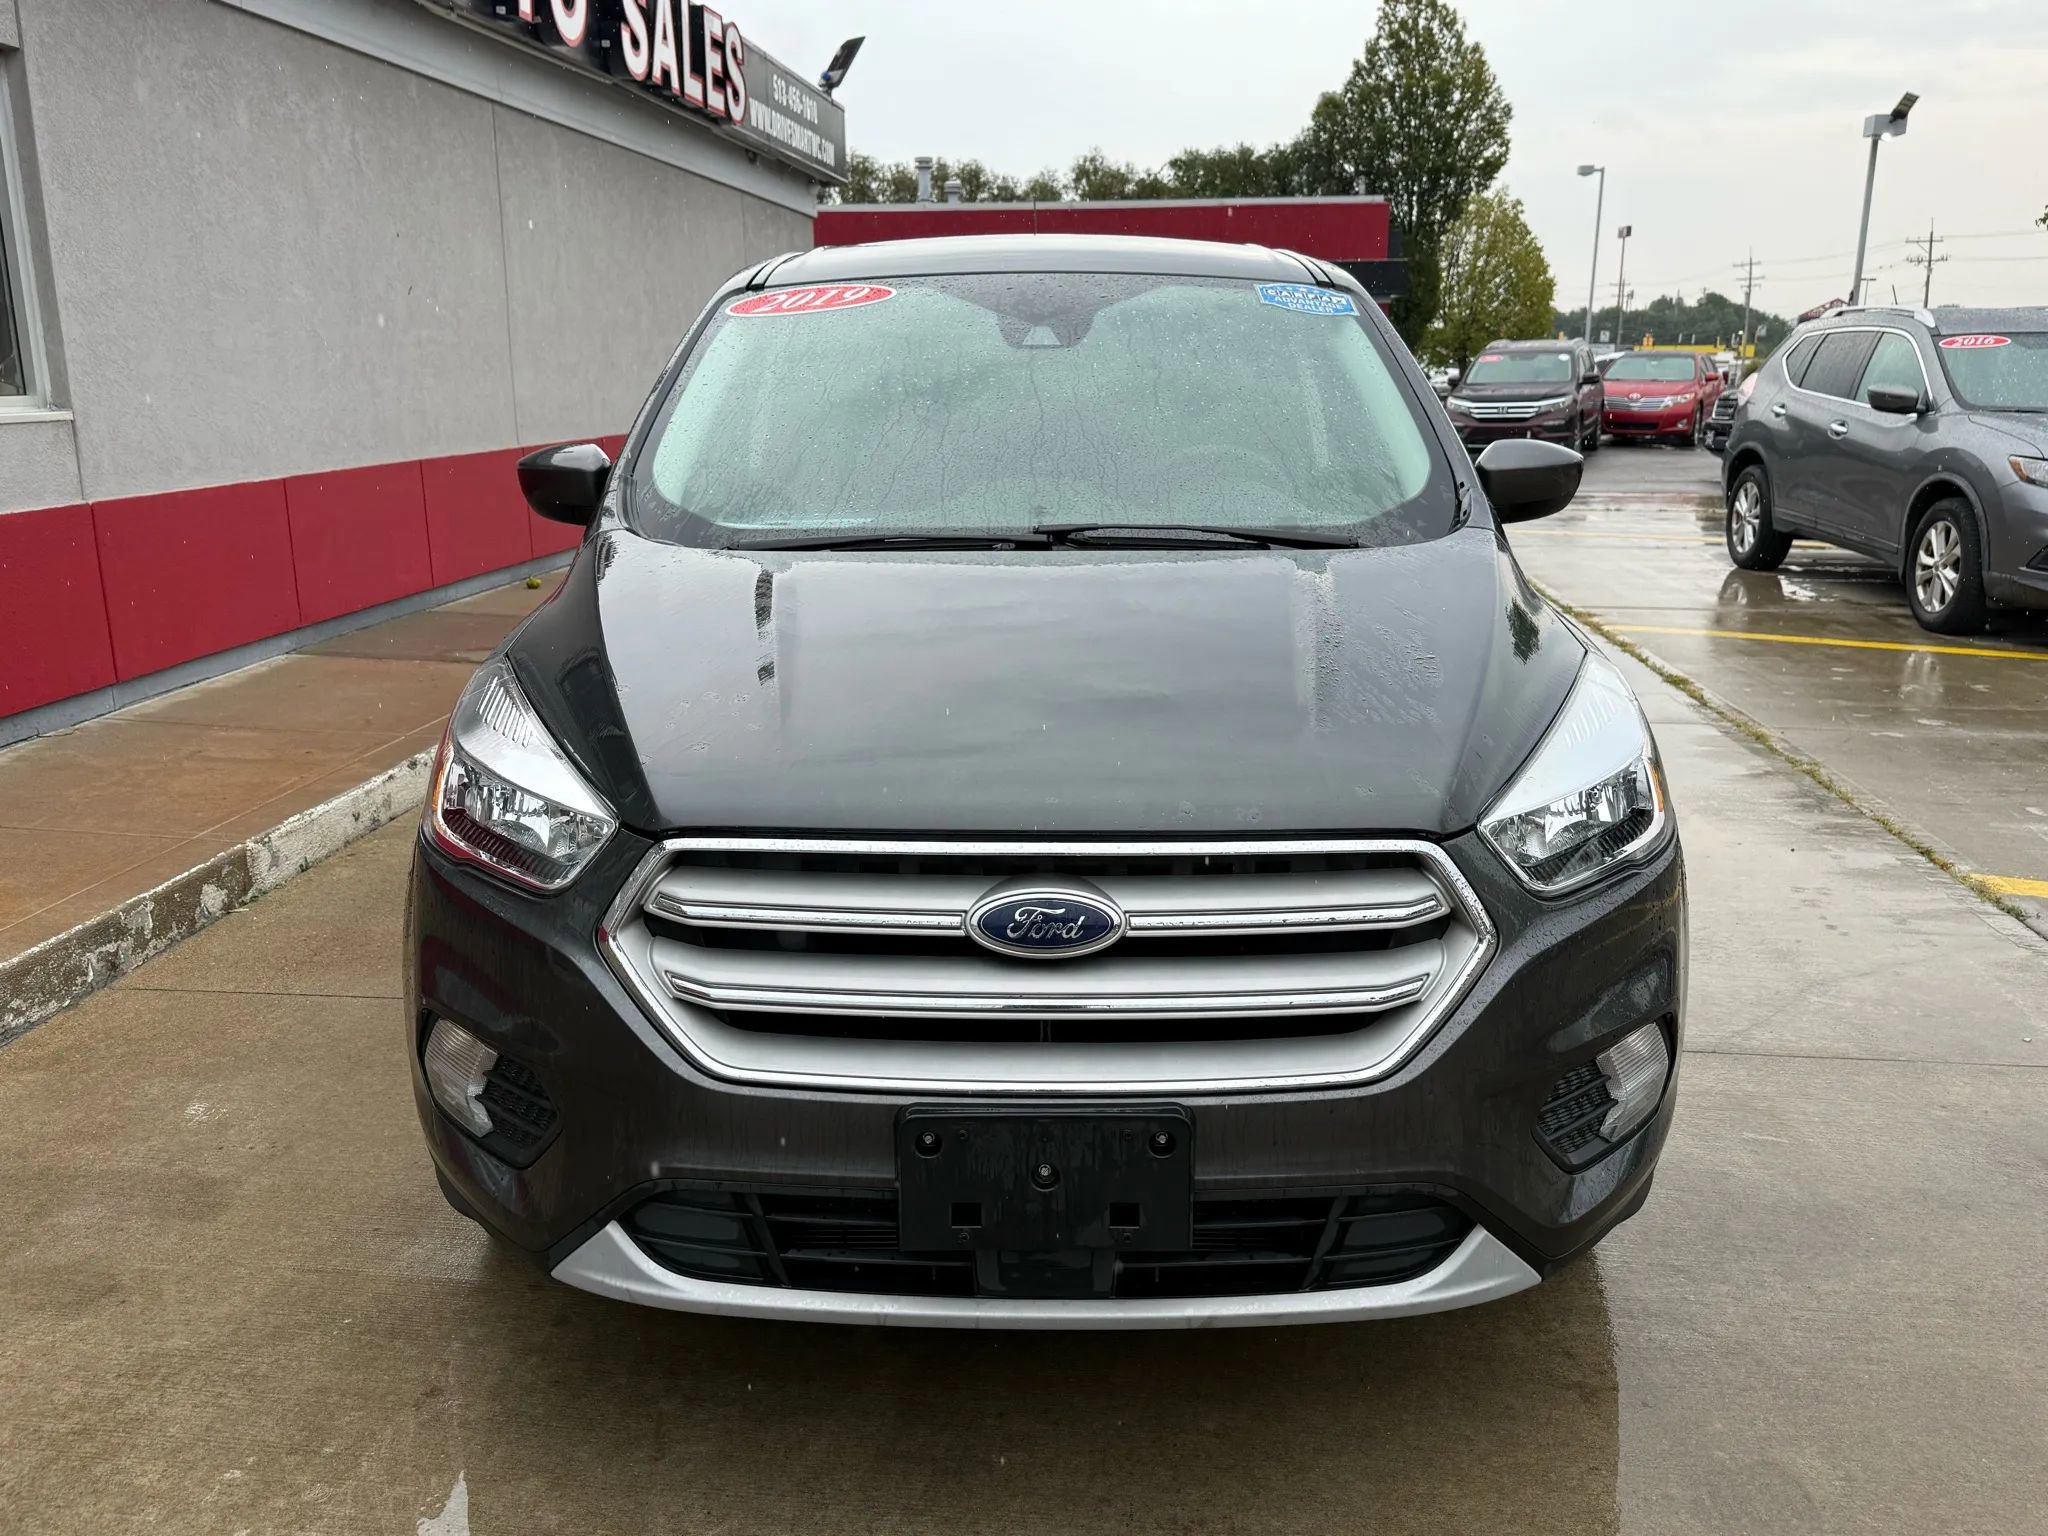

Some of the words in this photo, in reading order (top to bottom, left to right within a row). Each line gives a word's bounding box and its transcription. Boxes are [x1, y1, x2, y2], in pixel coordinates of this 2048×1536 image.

[620, 0, 747, 125] SALES
[751, 287, 872, 313] 2019
[1274, 296, 1344, 310] ADVANTAGE
[1288, 302, 1335, 313] DEALER
[1951, 336, 1995, 347] 2016
[1006, 906, 1086, 939] Ford
